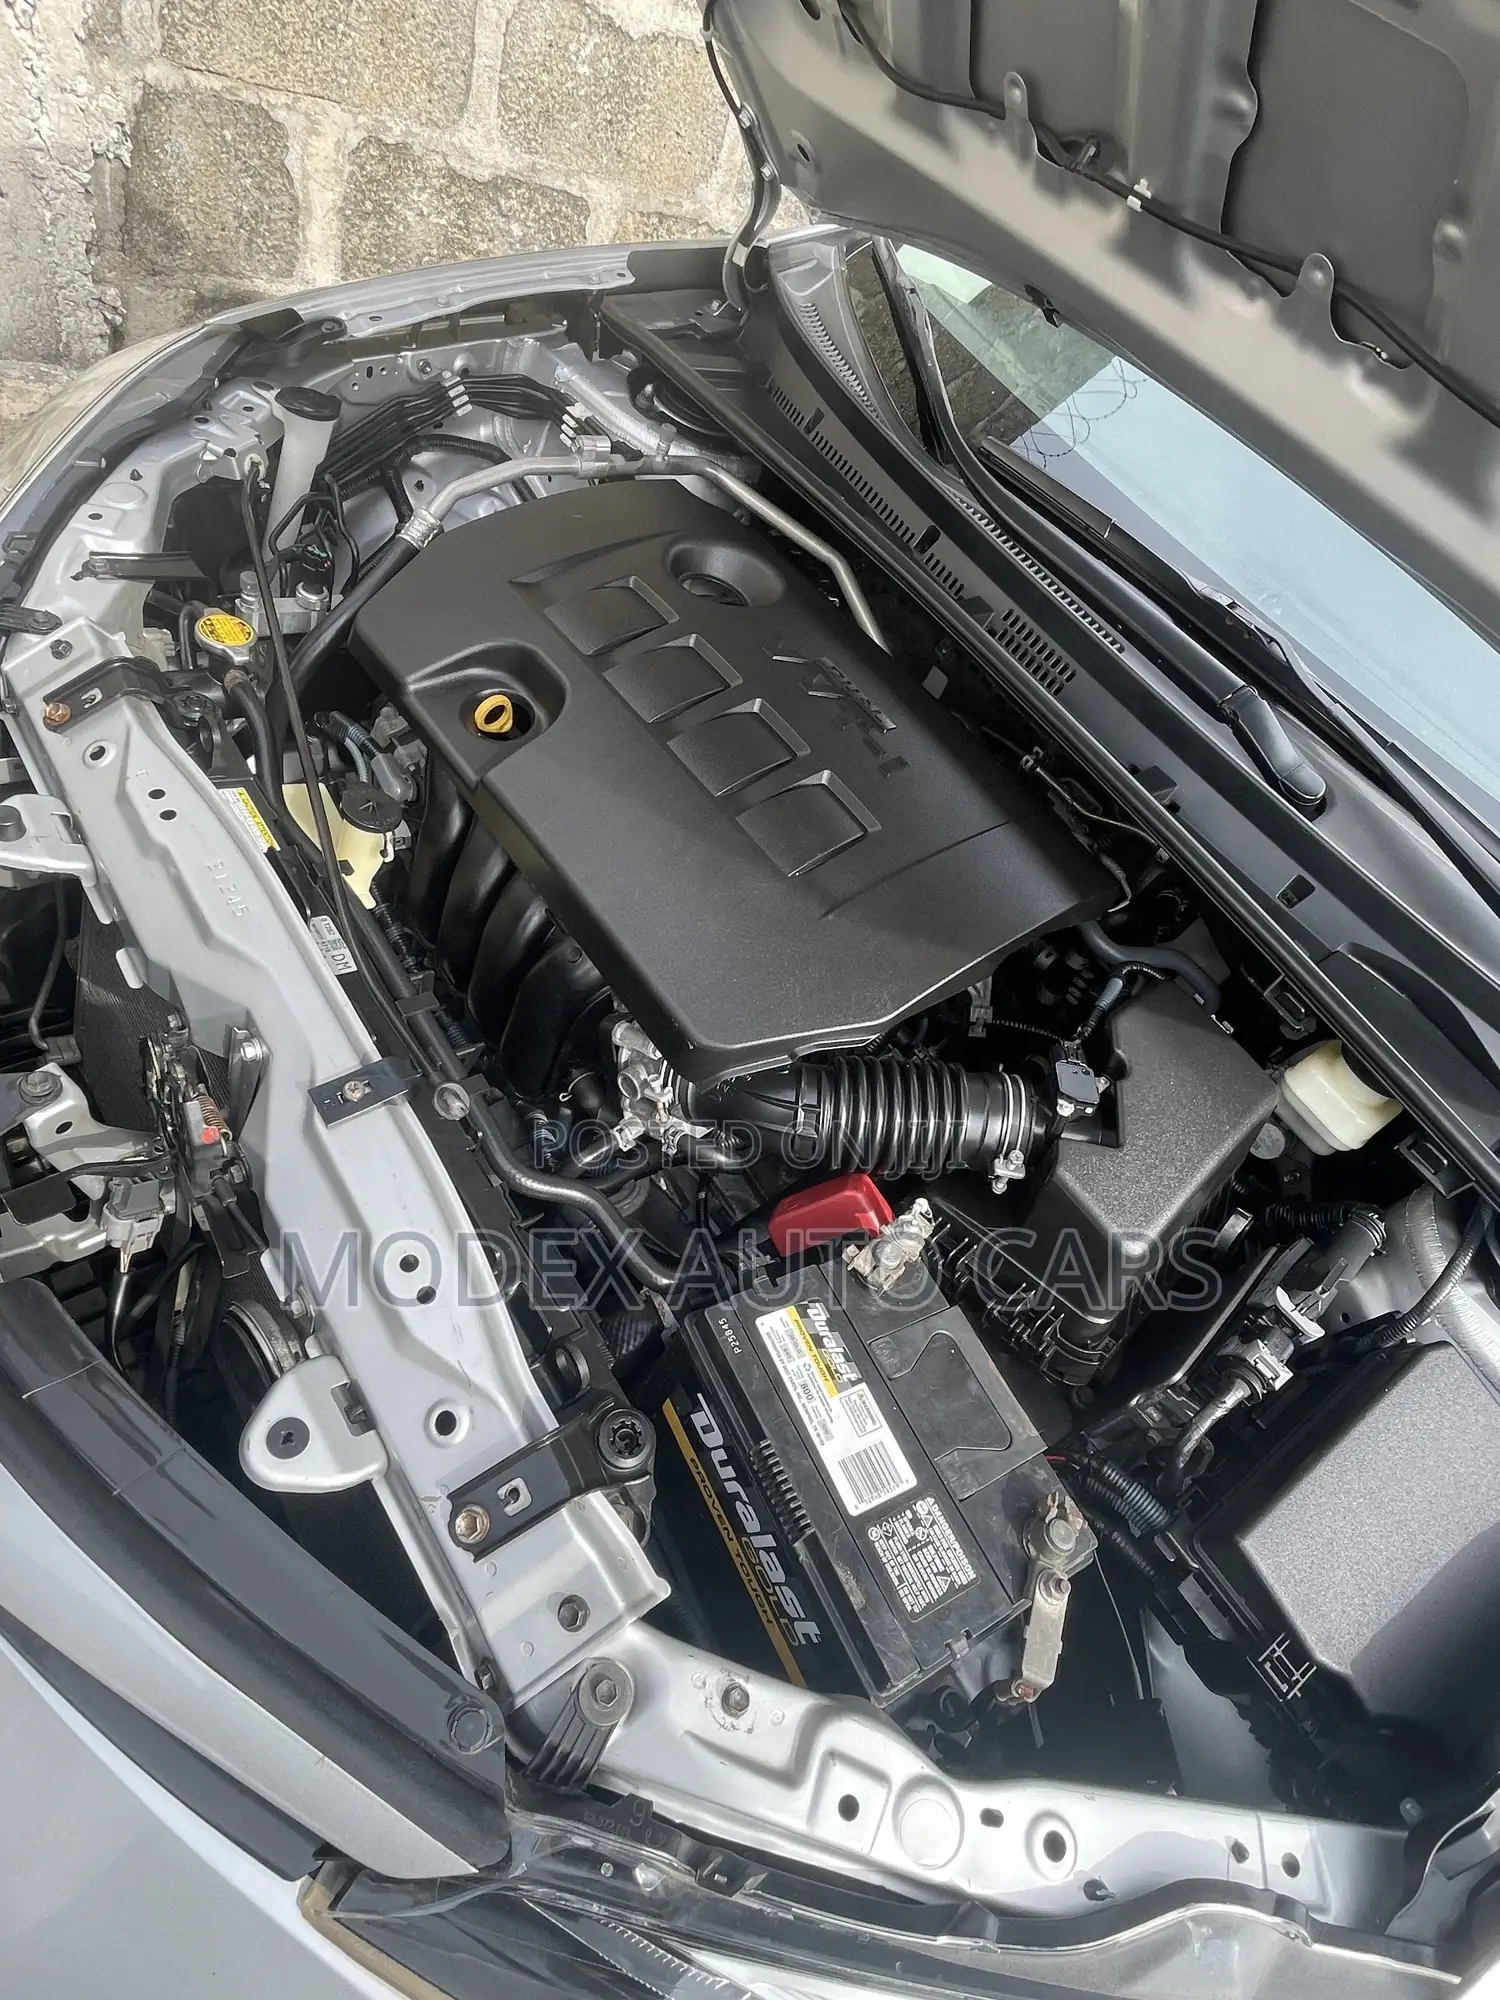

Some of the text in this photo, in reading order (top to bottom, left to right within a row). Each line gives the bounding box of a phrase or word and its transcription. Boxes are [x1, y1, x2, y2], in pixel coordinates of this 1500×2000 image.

[331, 953, 353, 971] DM
[718, 1317, 742, 1354] P25845
[792, 1318, 814, 1352] PROVEN
[811, 1353, 830, 1383] TOUGH
[806, 1303, 859, 1382] Duralast
[820, 1347, 844, 1384] GOLD
[799, 1381, 814, 1401] 800
[687, 1456, 774, 1625] PROVEN TOUGH
[689, 1391, 824, 1646] Duralast
[930, 1503, 976, 1580] DANGER/POISON
[737, 1534, 801, 1647] GOLD
